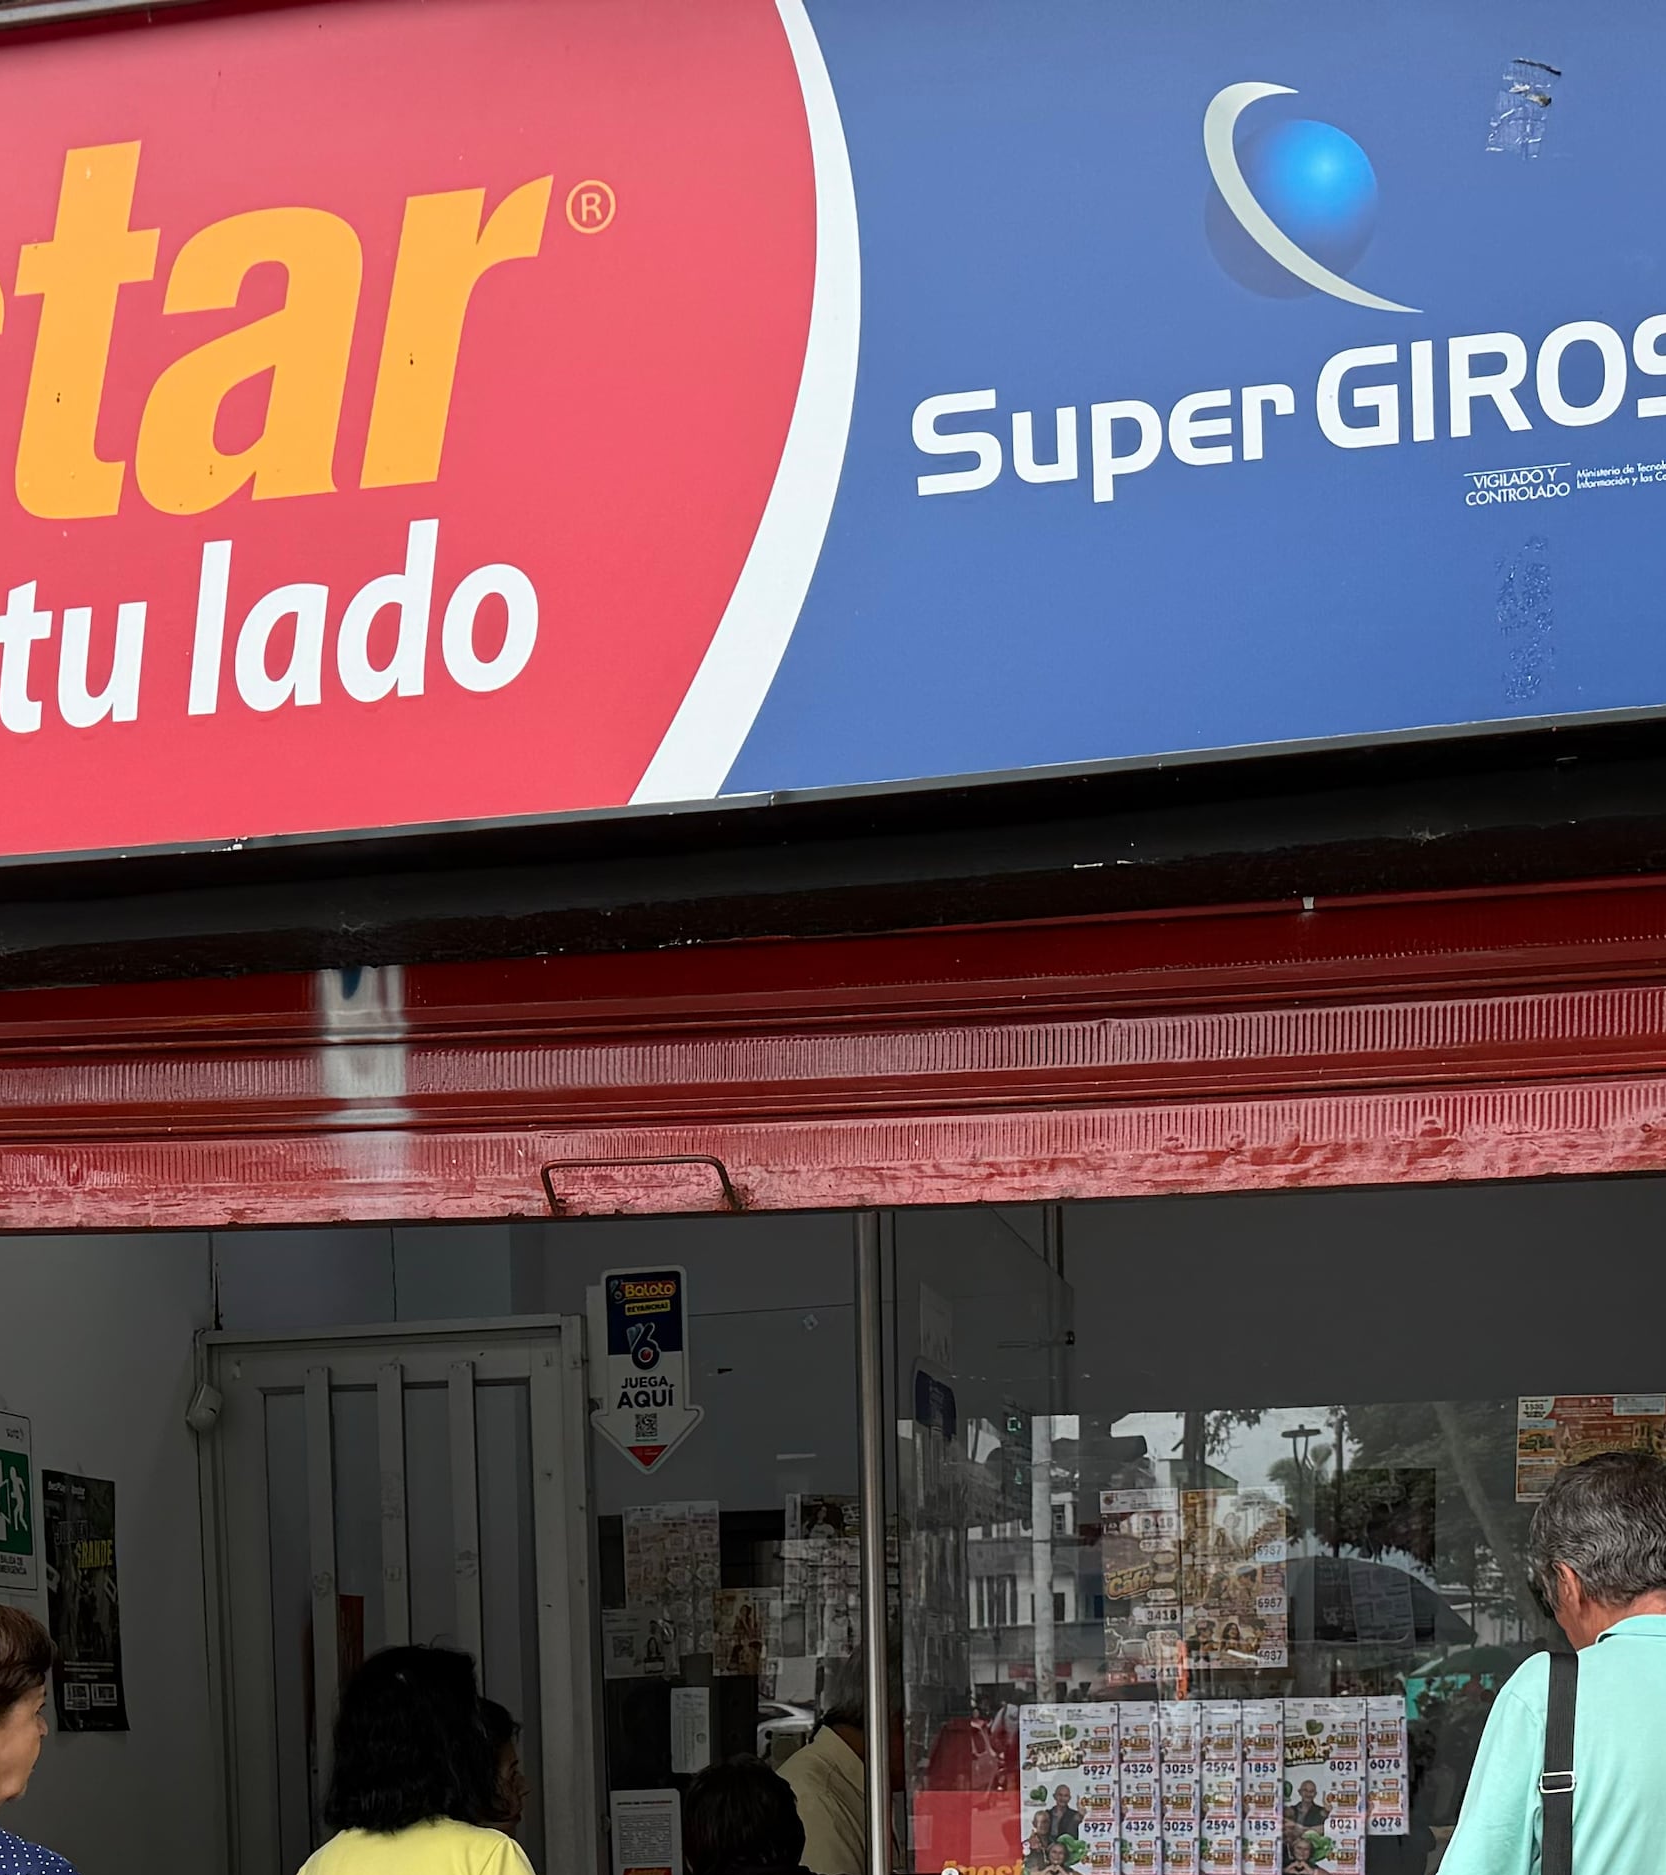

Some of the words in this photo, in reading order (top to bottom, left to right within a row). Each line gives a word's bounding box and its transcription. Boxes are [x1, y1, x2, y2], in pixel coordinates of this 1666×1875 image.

[911, 382, 1295, 502] Super
[1577, 466, 1621, 479] Ministerio
[1622, 464, 1635, 475] de
[1473, 469, 1544, 489] VIGILADO
[1546, 468, 1558, 482] Y
[1632, 476, 1639, 487] y
[1640, 471, 1654, 483] las
[1465, 482, 1571, 506] CONTROLADO
[188, 518, 539, 716] lado
[623, 1281, 676, 1299] Baloto
[621, 1375, 668, 1389] JUEGA
[617, 1383, 675, 1409] AQUÍ
[1083, 1764, 1112, 1776] 5927
[1123, 1763, 1153, 1774] 4326
[1164, 1763, 1194, 1774] 3025
[1205, 1762, 1236, 1773] 2594
[1248, 1762, 1277, 1773] 1853
[1329, 1760, 1359, 1772] 8021
[1084, 1822, 1113, 1833] 5927
[1125, 1821, 1154, 1832] 4326
[1164, 1821, 1193, 1832] 3025
[1206, 1820, 1236, 1830] 2594
[1248, 1819, 1276, 1831] 1853
[1329, 1819, 1358, 1830] 8021
